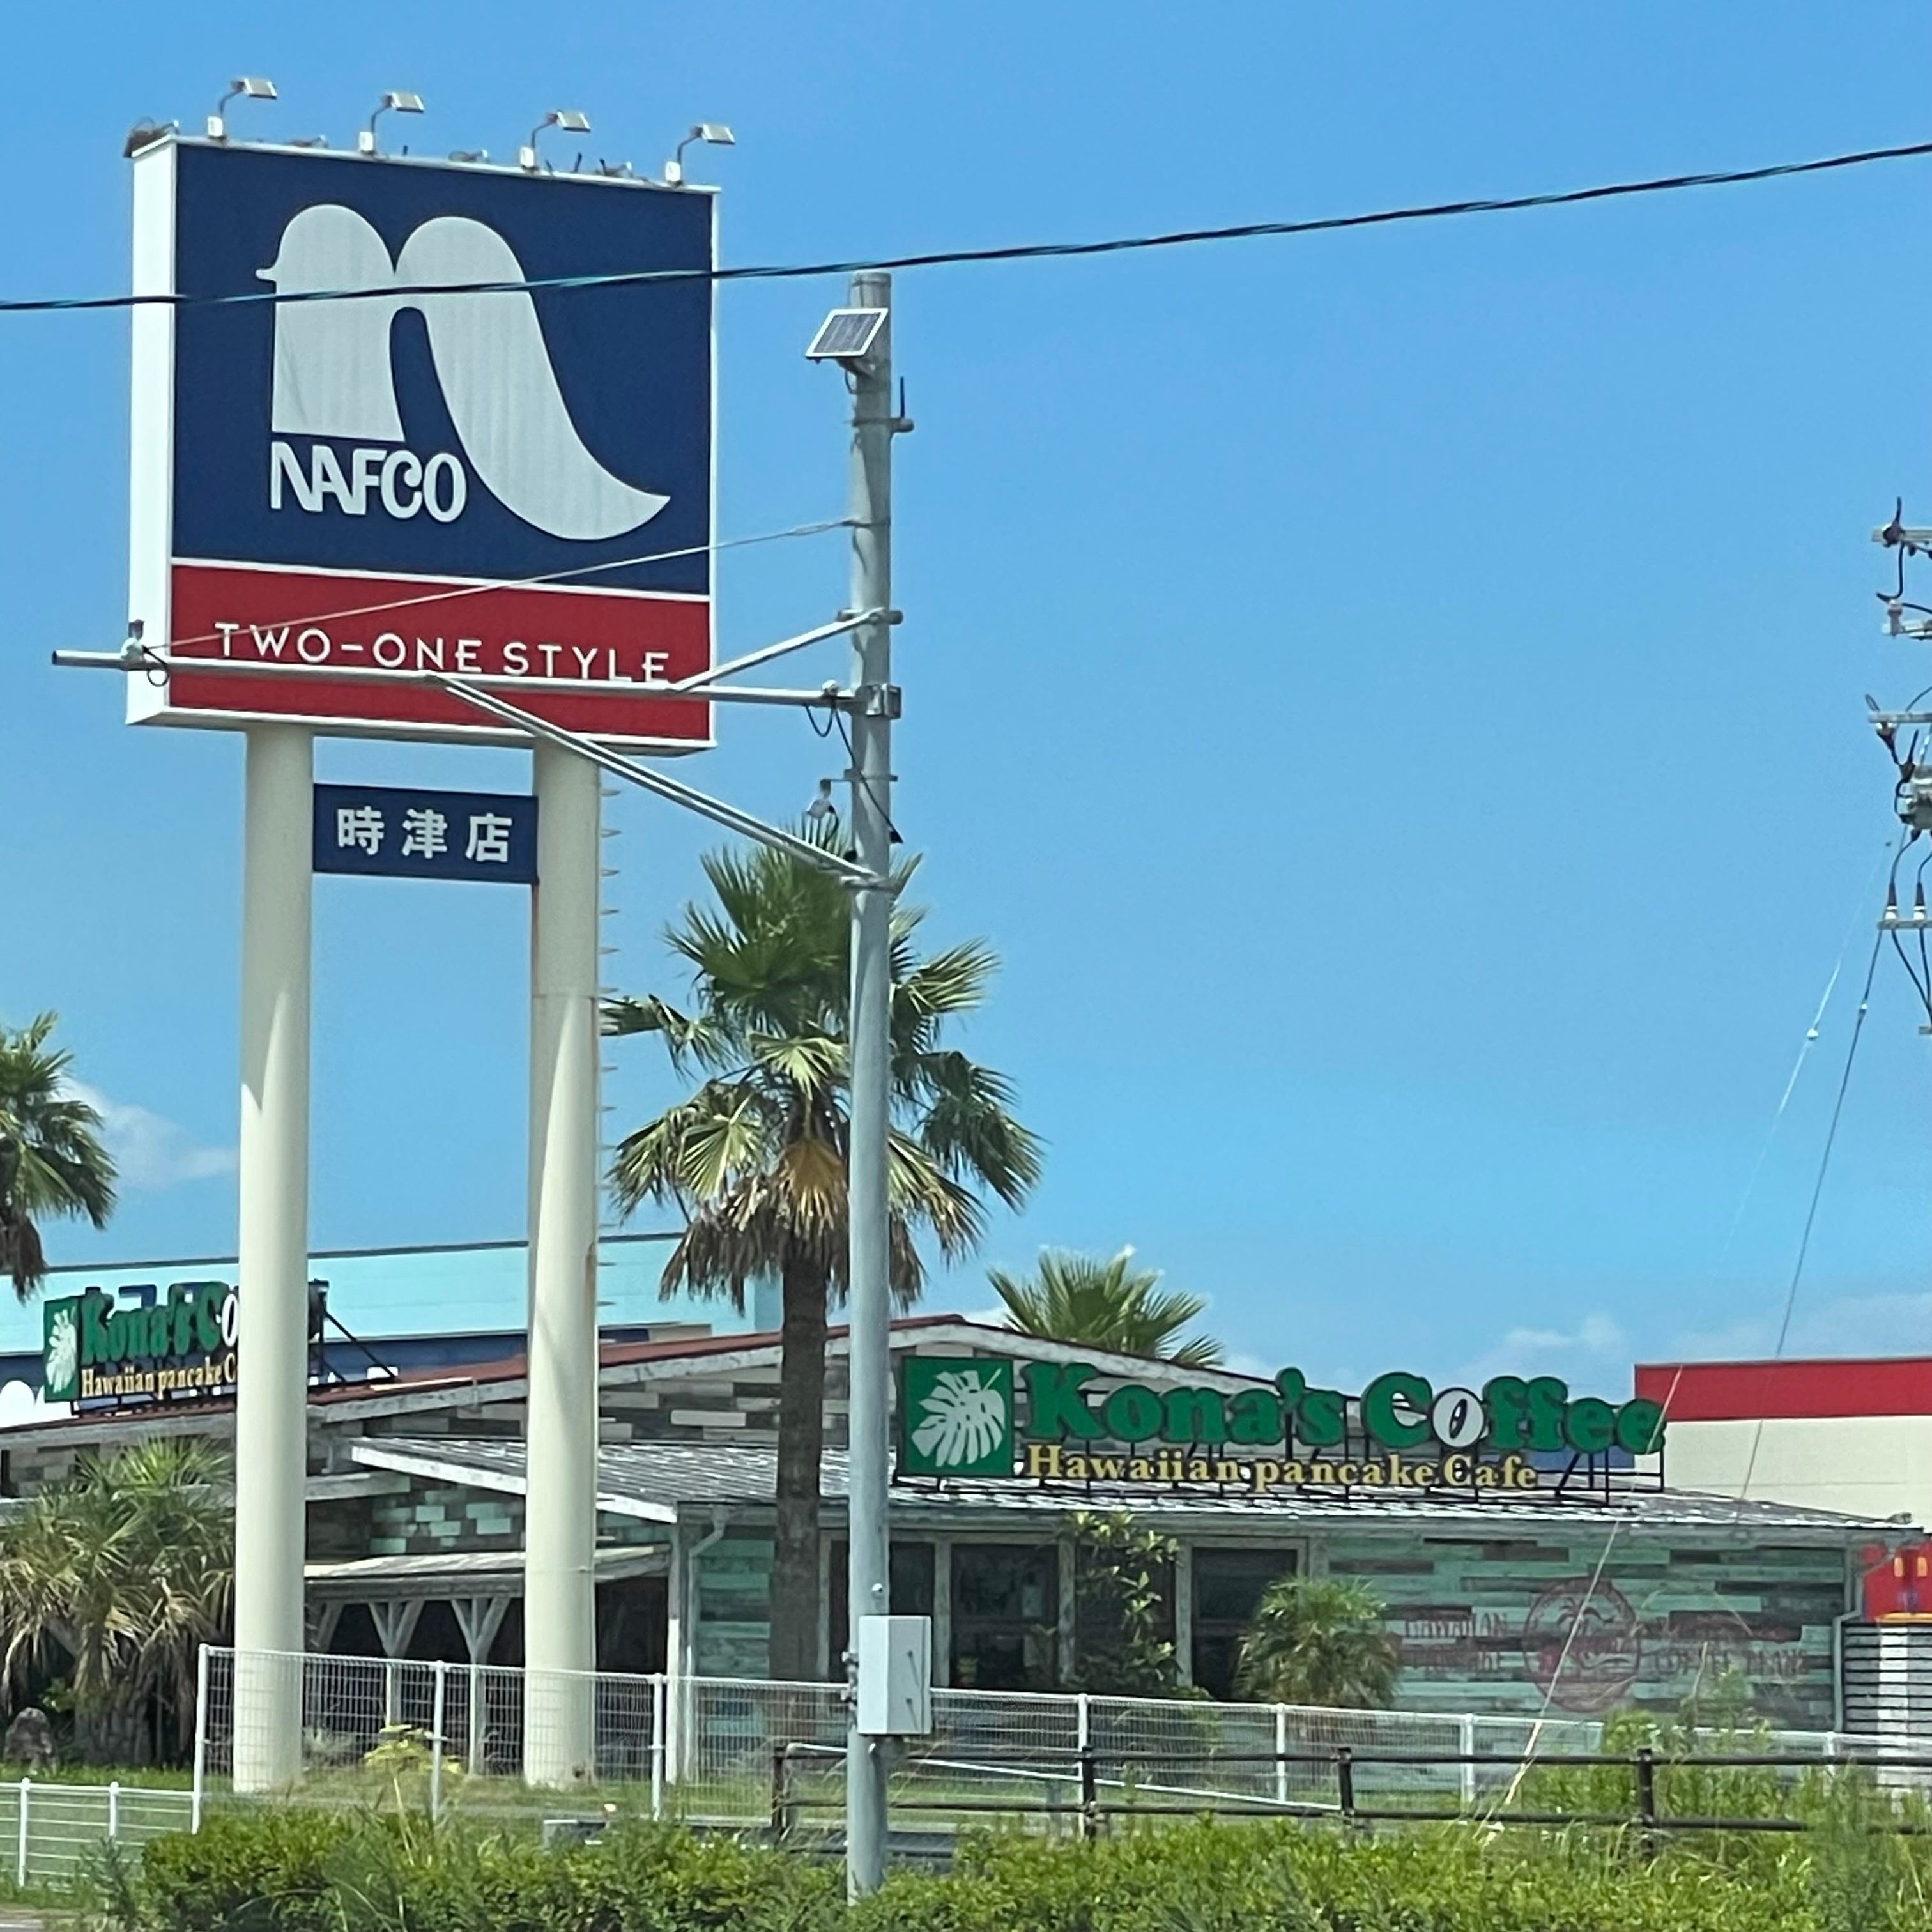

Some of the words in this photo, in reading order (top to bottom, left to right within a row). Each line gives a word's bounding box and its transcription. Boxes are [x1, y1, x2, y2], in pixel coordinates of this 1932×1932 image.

[271, 441, 468, 523] NAFCO
[215, 622, 482, 674] TWO-ONE
[503, 642, 670, 684] STYLE
[337, 806, 512, 862] 時津店
[82, 1364, 155, 1398] Hawaiian
[157, 1356, 222, 1400] pancake
[1022, 1361, 1346, 1447] Kona's
[1360, 1371, 1667, 1454] Coffee
[1026, 1444, 1244, 1482] Hawaiian
[1253, 1455, 1434, 1492] pancake
[1443, 1454, 1537, 1489] Cafe
